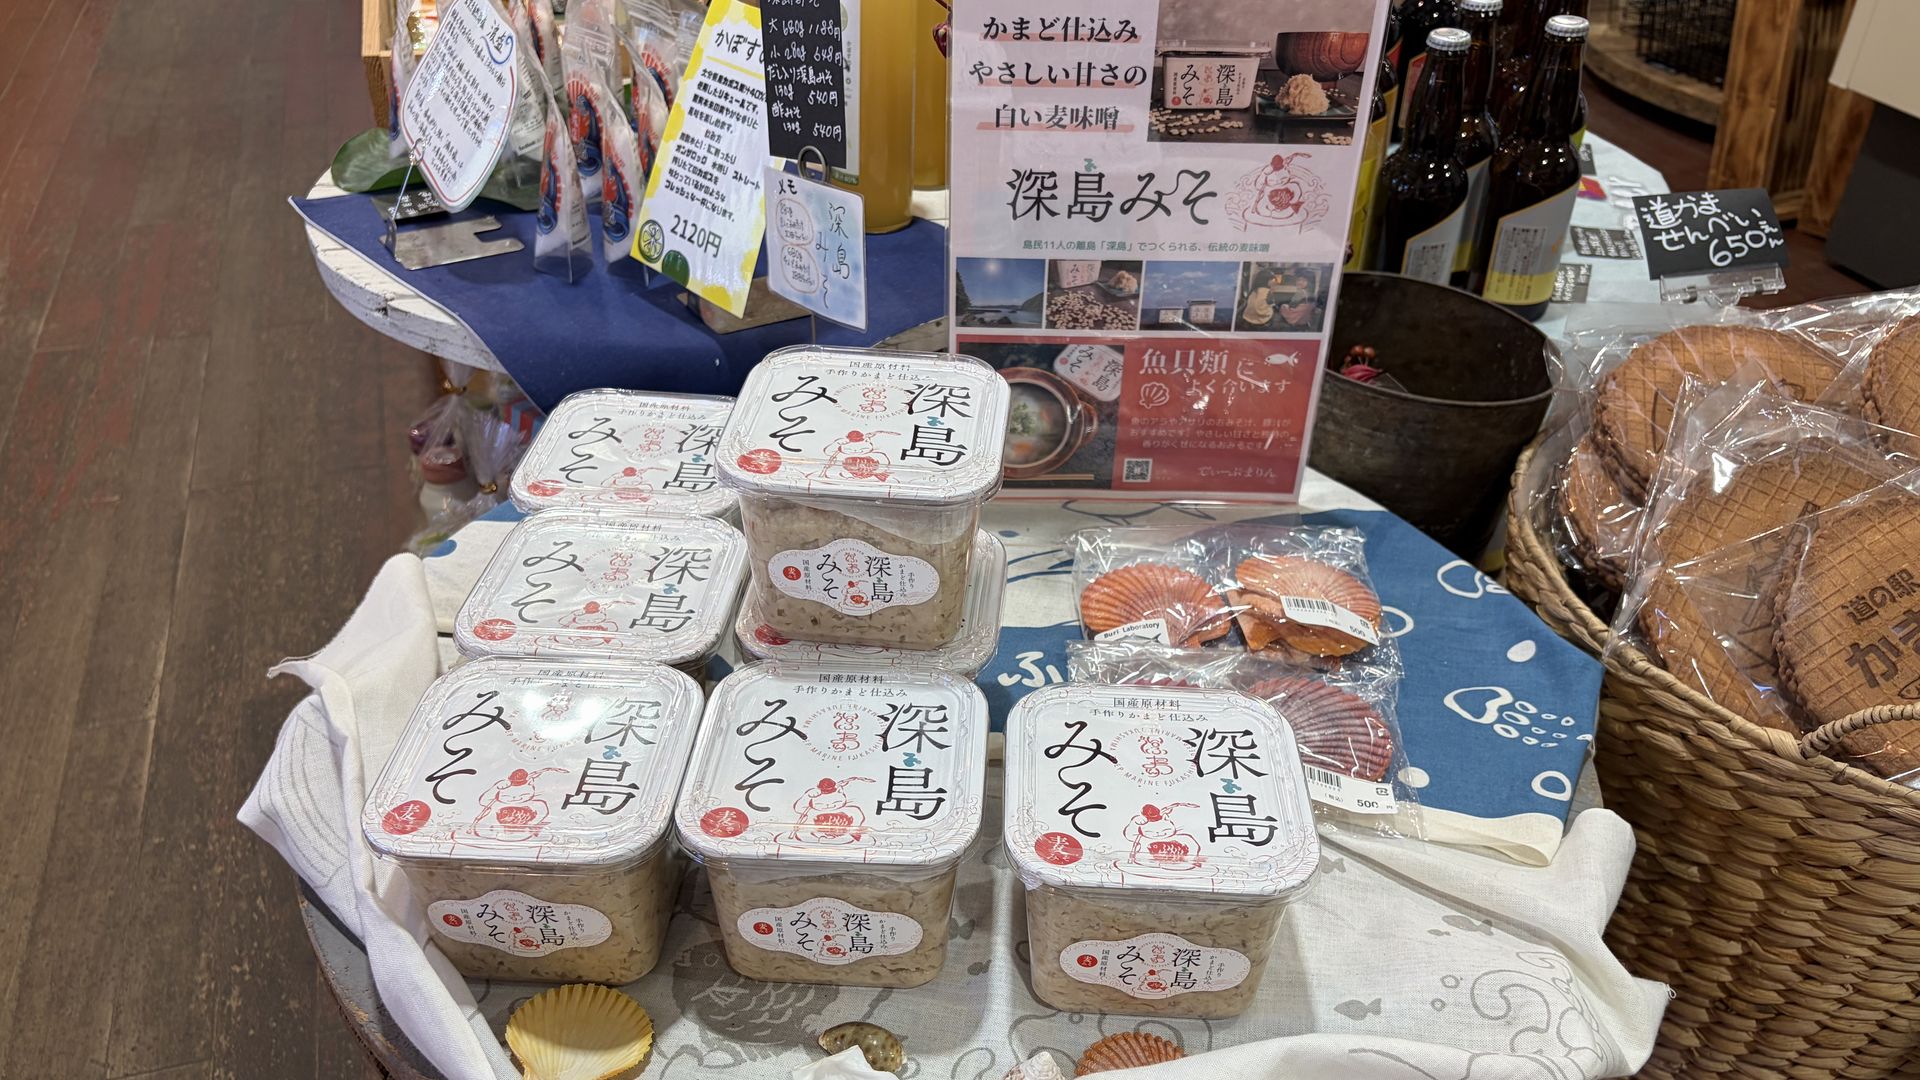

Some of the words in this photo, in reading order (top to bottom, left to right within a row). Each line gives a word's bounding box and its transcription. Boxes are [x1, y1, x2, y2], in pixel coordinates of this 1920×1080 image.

[769, 18, 778, 33] 大
[782, 19, 804, 38] 680g
[809, 19, 841, 42] 1188円
[982, 16, 1138, 43] かまど仕込み
[770, 44, 780, 59] 小
[784, 41, 806, 62] 280g
[813, 45, 842, 67] 648円
[968, 60, 1148, 88] やさしい甘さの
[807, 90, 838, 108] 540円
[1180, 64, 1200, 106] みそ
[1216, 64, 1236, 107] 深島
[812, 122, 841, 142] 540円
[994, 104, 1120, 130] 白い麦味噌
[778, 179, 798, 195] メモ
[1005, 168, 1218, 225] 深島みそ
[670, 214, 722, 259] 2120円
[768, 375, 839, 453] みそ
[899, 382, 974, 466] 深島
[559, 417, 622, 483] みそ
[662, 423, 724, 493] 深島
[511, 541, 584, 623] みそ
[629, 546, 713, 633] 深島
[816, 553, 843, 600] みそ
[864, 554, 895, 604] 深島
[1840, 568, 1920, 625] 道の駅
[1103, 628, 1120, 639] Buri
[1122, 621, 1161, 633] Laboratory
[792, 684, 909, 698] 手作りかまど仕込み
[818, 672, 886, 685] 国産原材料
[1088, 708, 1209, 723] 手作りかまど仕込み
[1112, 696, 1182, 710] 国産原材料
[424, 690, 512, 805] みそ
[560, 699, 662, 815] 深島
[735, 698, 808, 813] みそ
[875, 702, 953, 821] 深島
[1043, 720, 1119, 839] みそ
[1182, 727, 1279, 847] 深島
[476, 903, 506, 944] みそ
[525, 904, 565, 946] 深島
[789, 911, 818, 951] みそ
[841, 912, 874, 954] 深島
[1116, 945, 1145, 986] みそ
[1170, 948, 1203, 990] 深島
